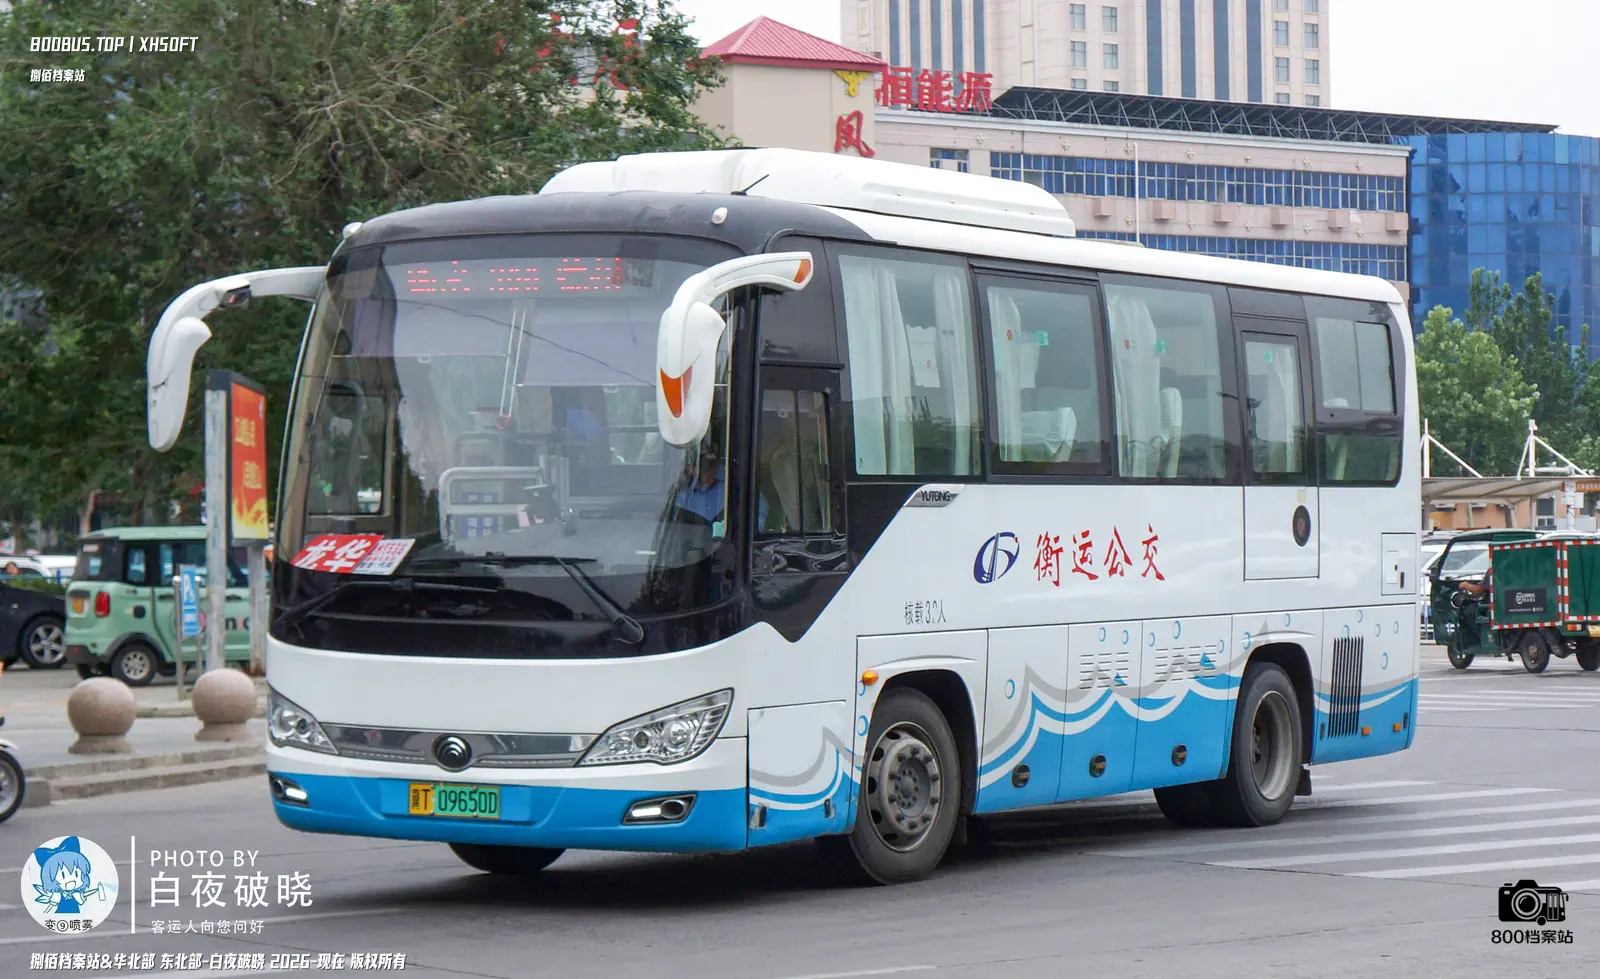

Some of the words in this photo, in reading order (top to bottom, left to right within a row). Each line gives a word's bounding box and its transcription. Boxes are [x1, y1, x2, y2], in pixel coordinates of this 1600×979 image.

[920, 490, 951, 502] YUTONG
[1032, 523, 1166, 588] 衡运公交
